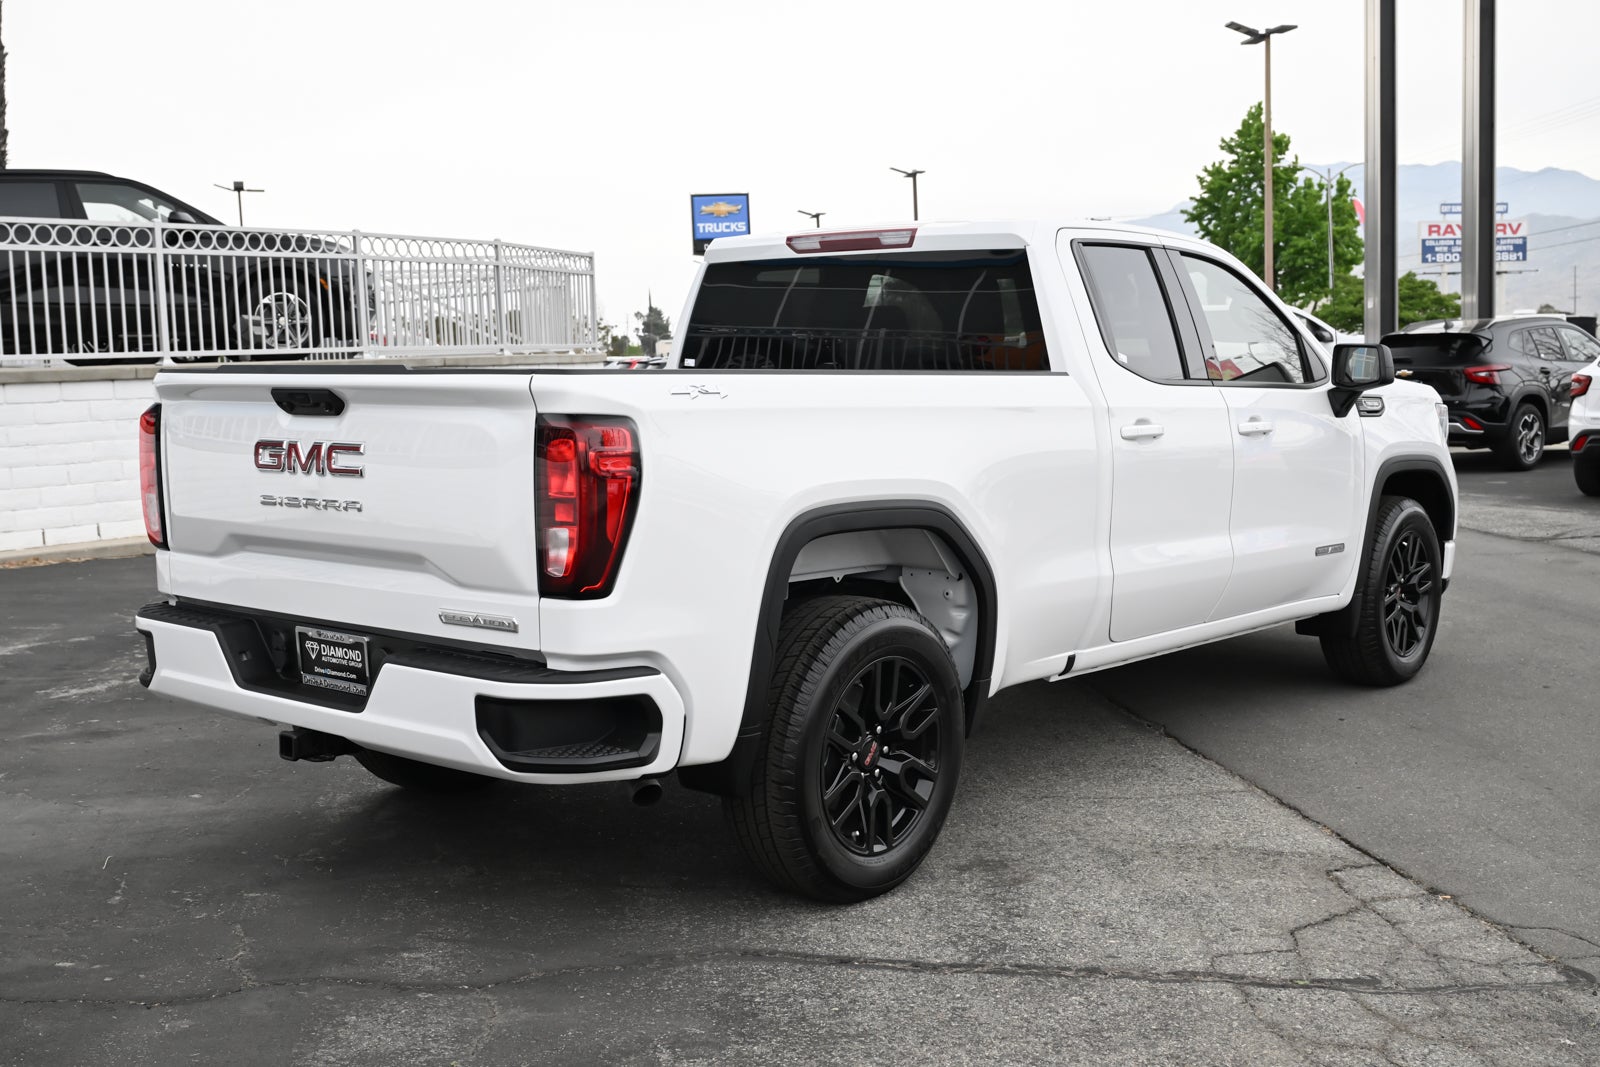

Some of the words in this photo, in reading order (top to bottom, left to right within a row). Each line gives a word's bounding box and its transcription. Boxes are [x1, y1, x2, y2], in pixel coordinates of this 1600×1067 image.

[696, 221, 747, 233] TRUCKS
[254, 439, 365, 478] GMC
[260, 494, 363, 513] SIERRA
[320, 643, 362, 662] DIAMOND
[321, 656, 348, 666] AUTOMOTIVE
[348, 660, 363, 668] GROUP
